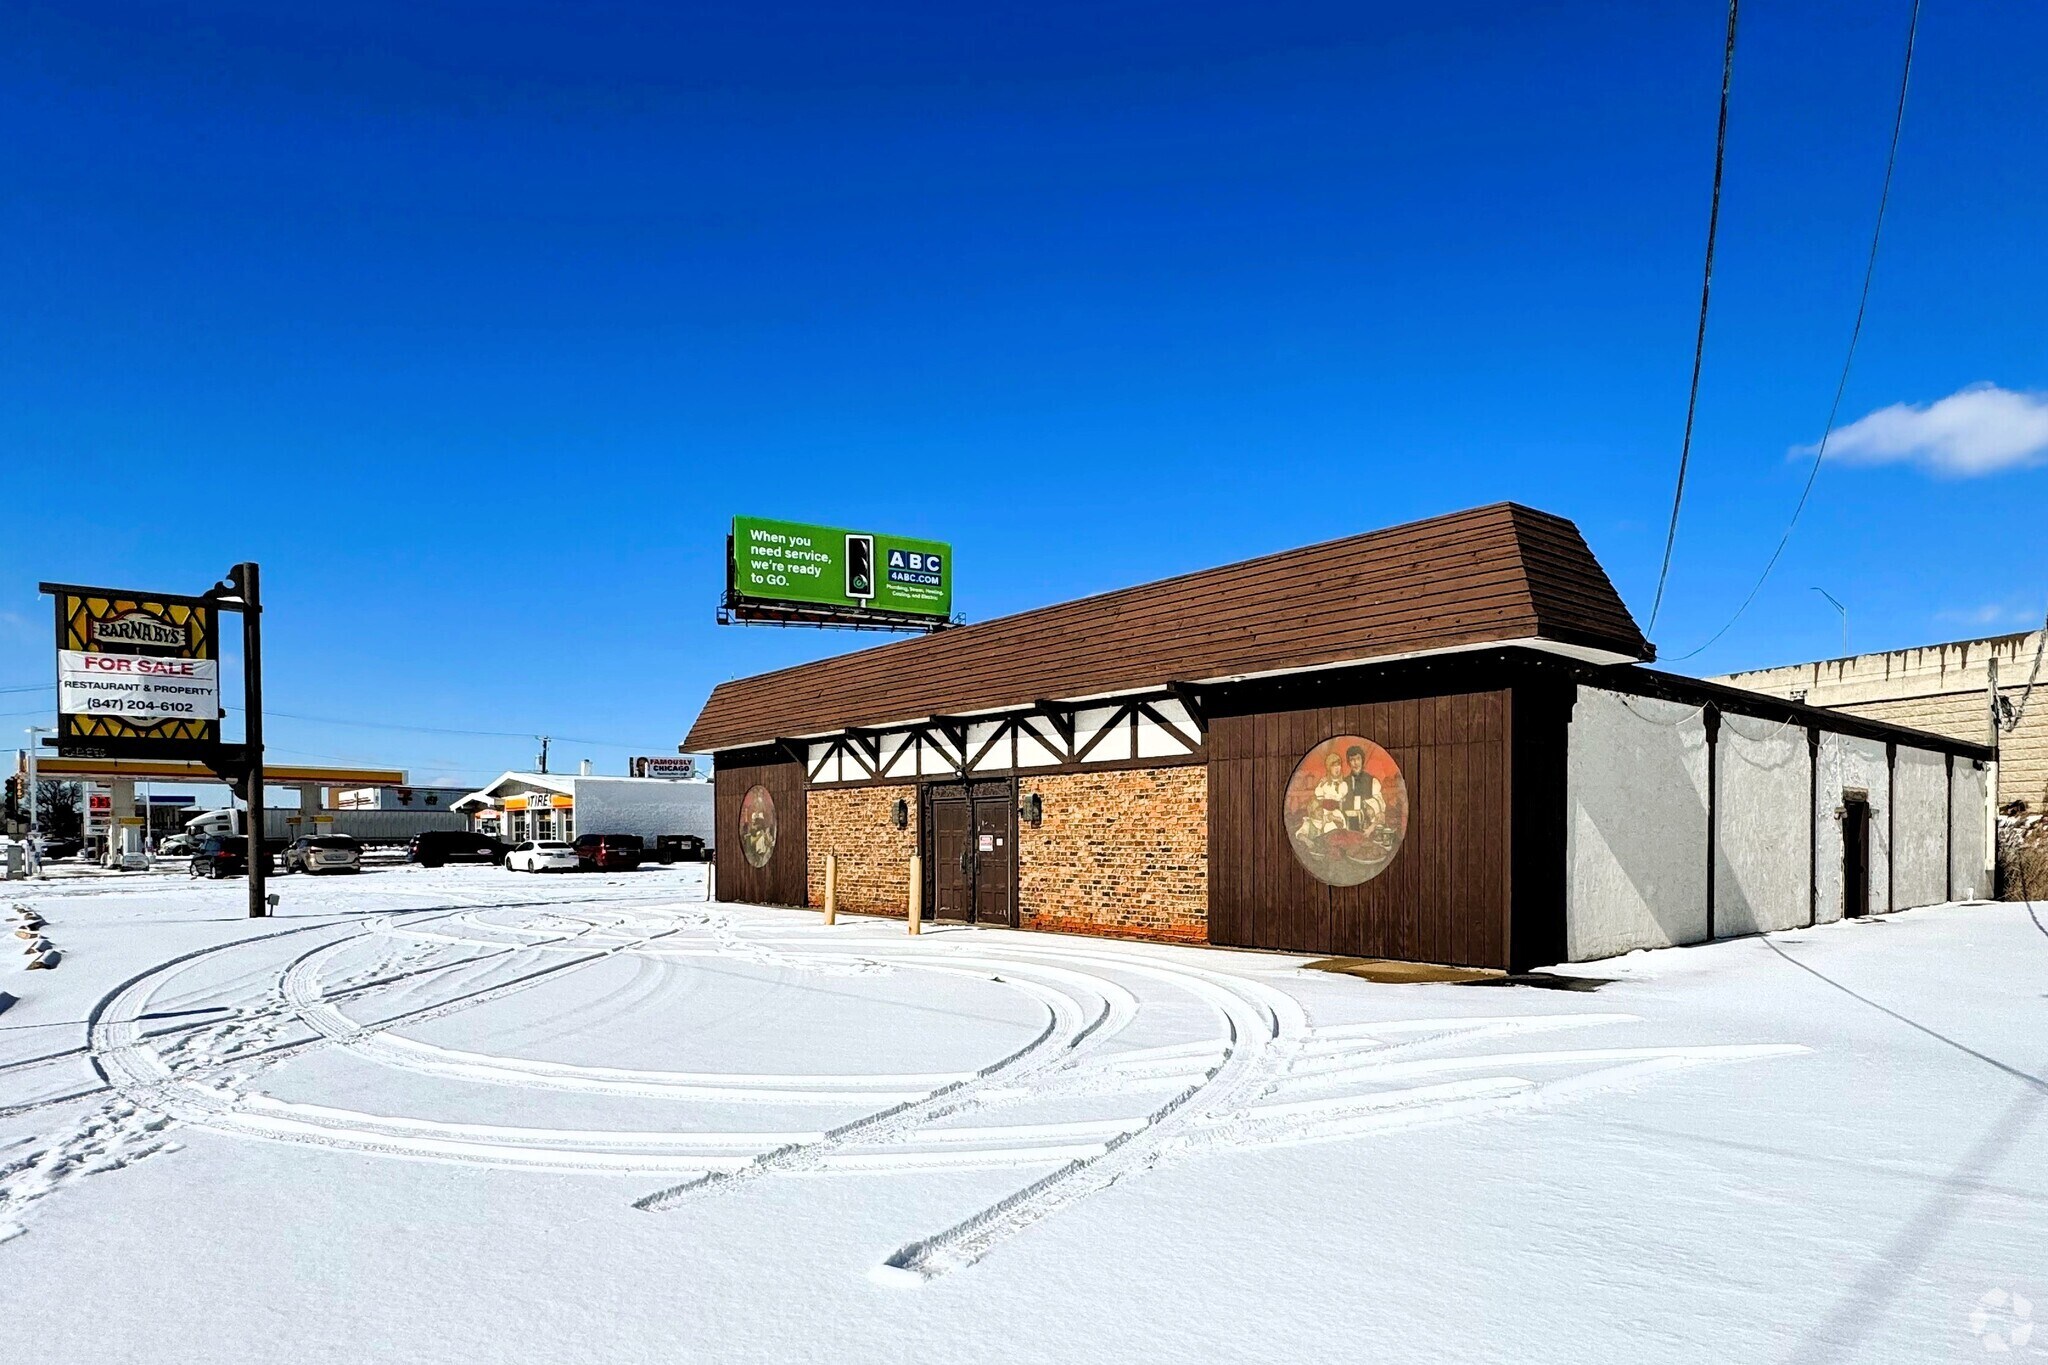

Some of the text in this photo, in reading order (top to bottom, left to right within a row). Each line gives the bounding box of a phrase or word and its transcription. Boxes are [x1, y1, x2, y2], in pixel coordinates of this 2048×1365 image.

[750, 530, 811, 547] When you
[751, 546, 832, 564] need service,
[890, 551, 940, 572] ABC
[751, 560, 822, 577] we're ready
[751, 573, 790, 586] to GO.
[891, 572, 939, 585] 4ABC.COM
[84, 656, 194, 676] FOR SALE
[64, 681, 213, 696] RESTAURANT & PROPERTY
[87, 697, 193, 712] (847) 204-6102
[530, 794, 549, 807] TIRE
